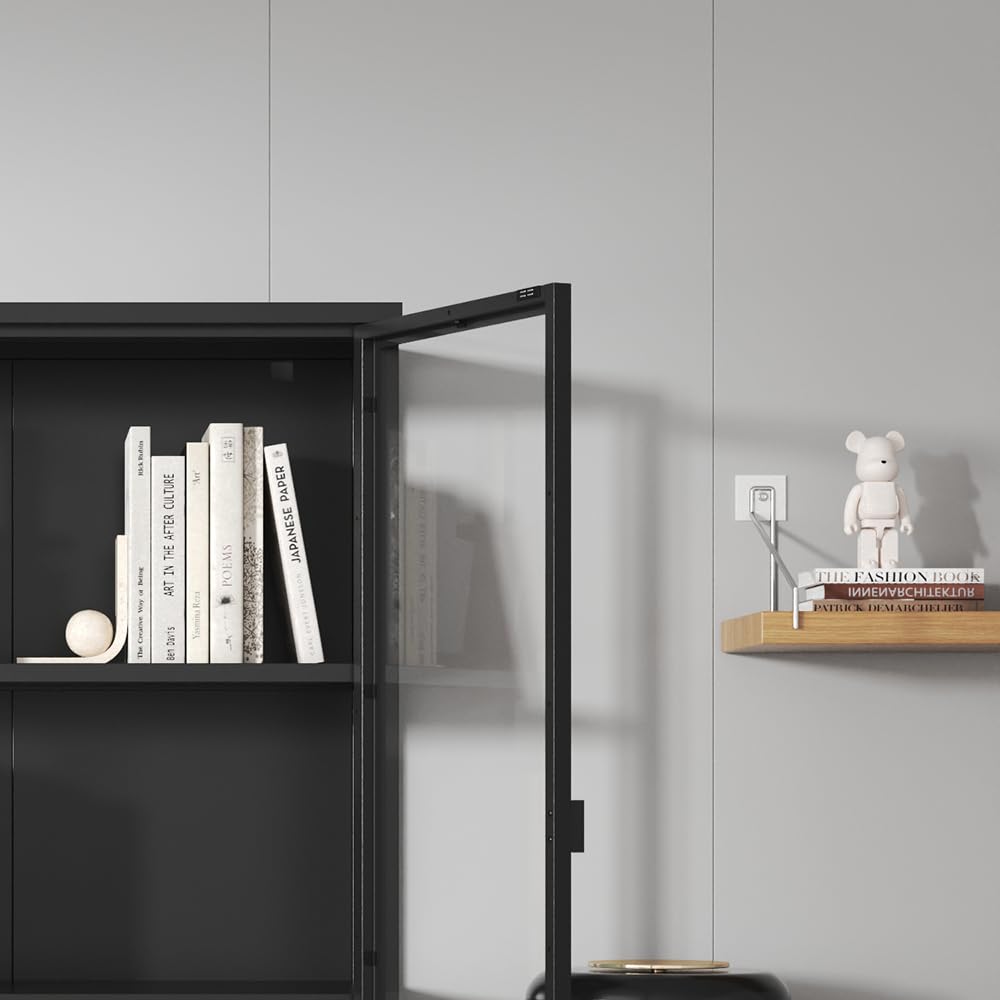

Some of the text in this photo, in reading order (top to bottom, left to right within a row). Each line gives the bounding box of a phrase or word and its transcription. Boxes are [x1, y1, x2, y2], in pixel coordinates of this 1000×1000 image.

[163, 474, 174, 597] ART IN THE AFTER CULTURE
[275, 465, 301, 563] JAPANESE PAPER
[222, 544, 232, 586] POEMS
[817, 571, 980, 582] THE FASHION BOOK
[192, 591, 200, 639] Yasmina Reza
[166, 627, 175, 660] Ben Davis
